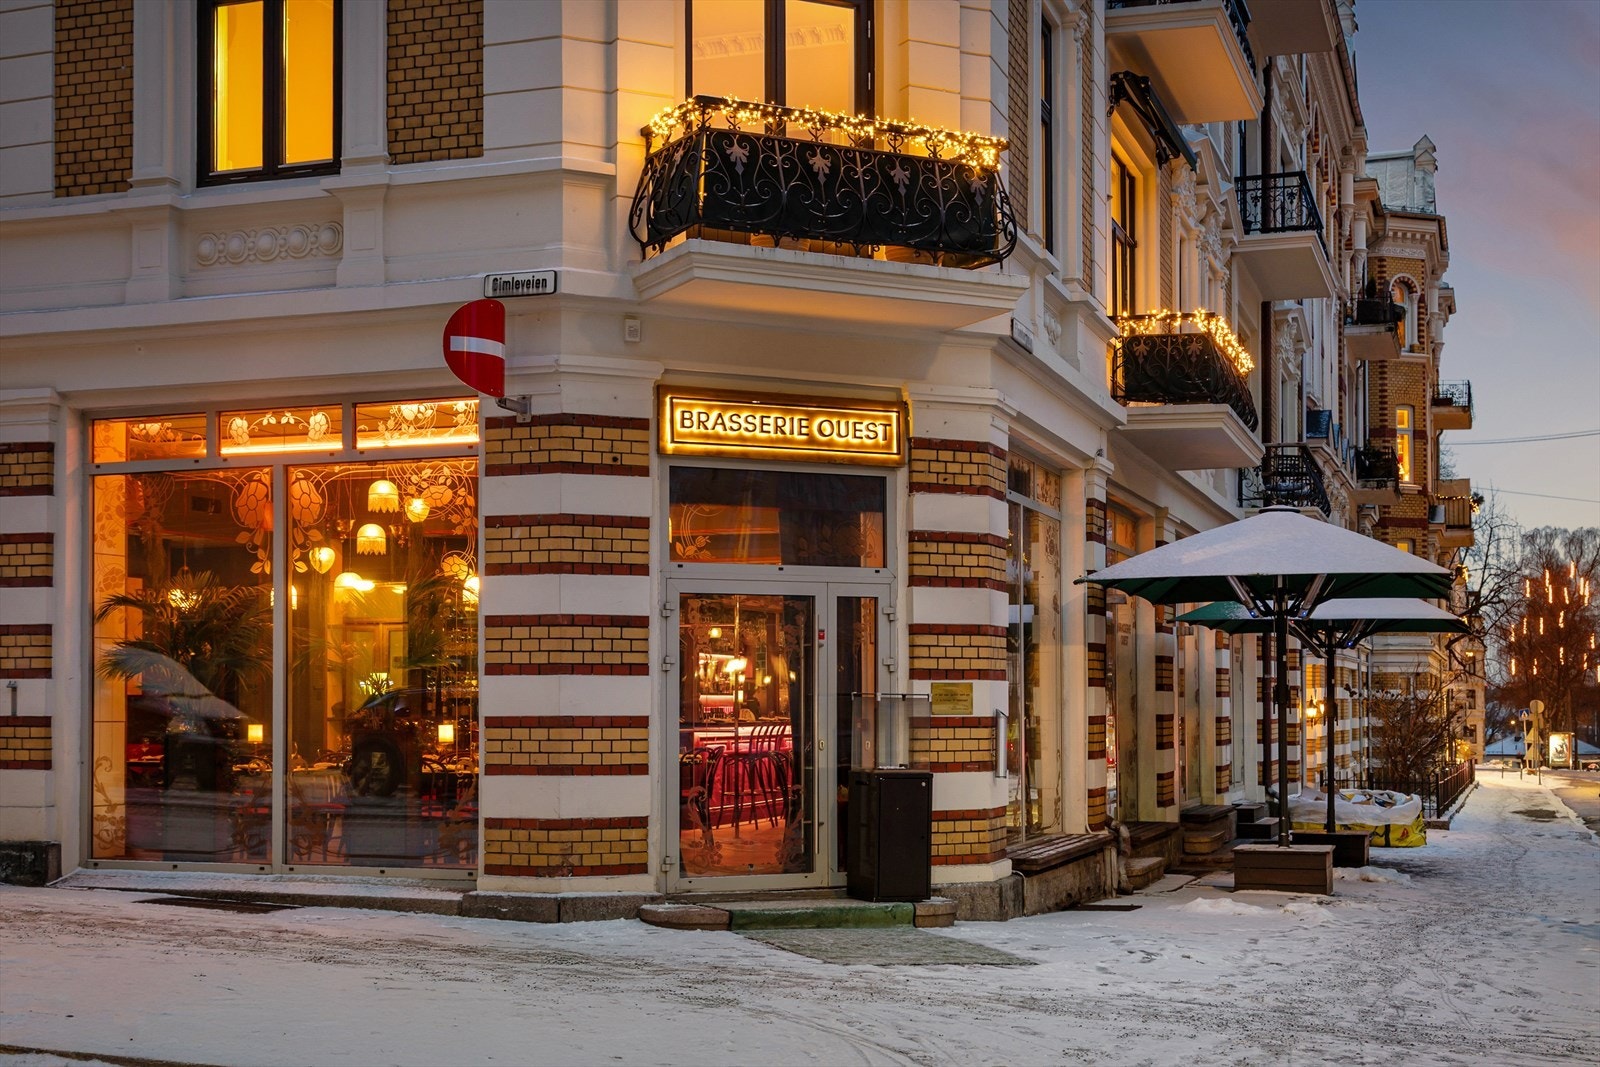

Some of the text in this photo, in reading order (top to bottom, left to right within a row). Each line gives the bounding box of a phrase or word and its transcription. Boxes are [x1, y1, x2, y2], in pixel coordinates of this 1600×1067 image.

[492, 275, 547, 291] Gimleveien
[679, 410, 892, 441] BRASSERIE OUEST
